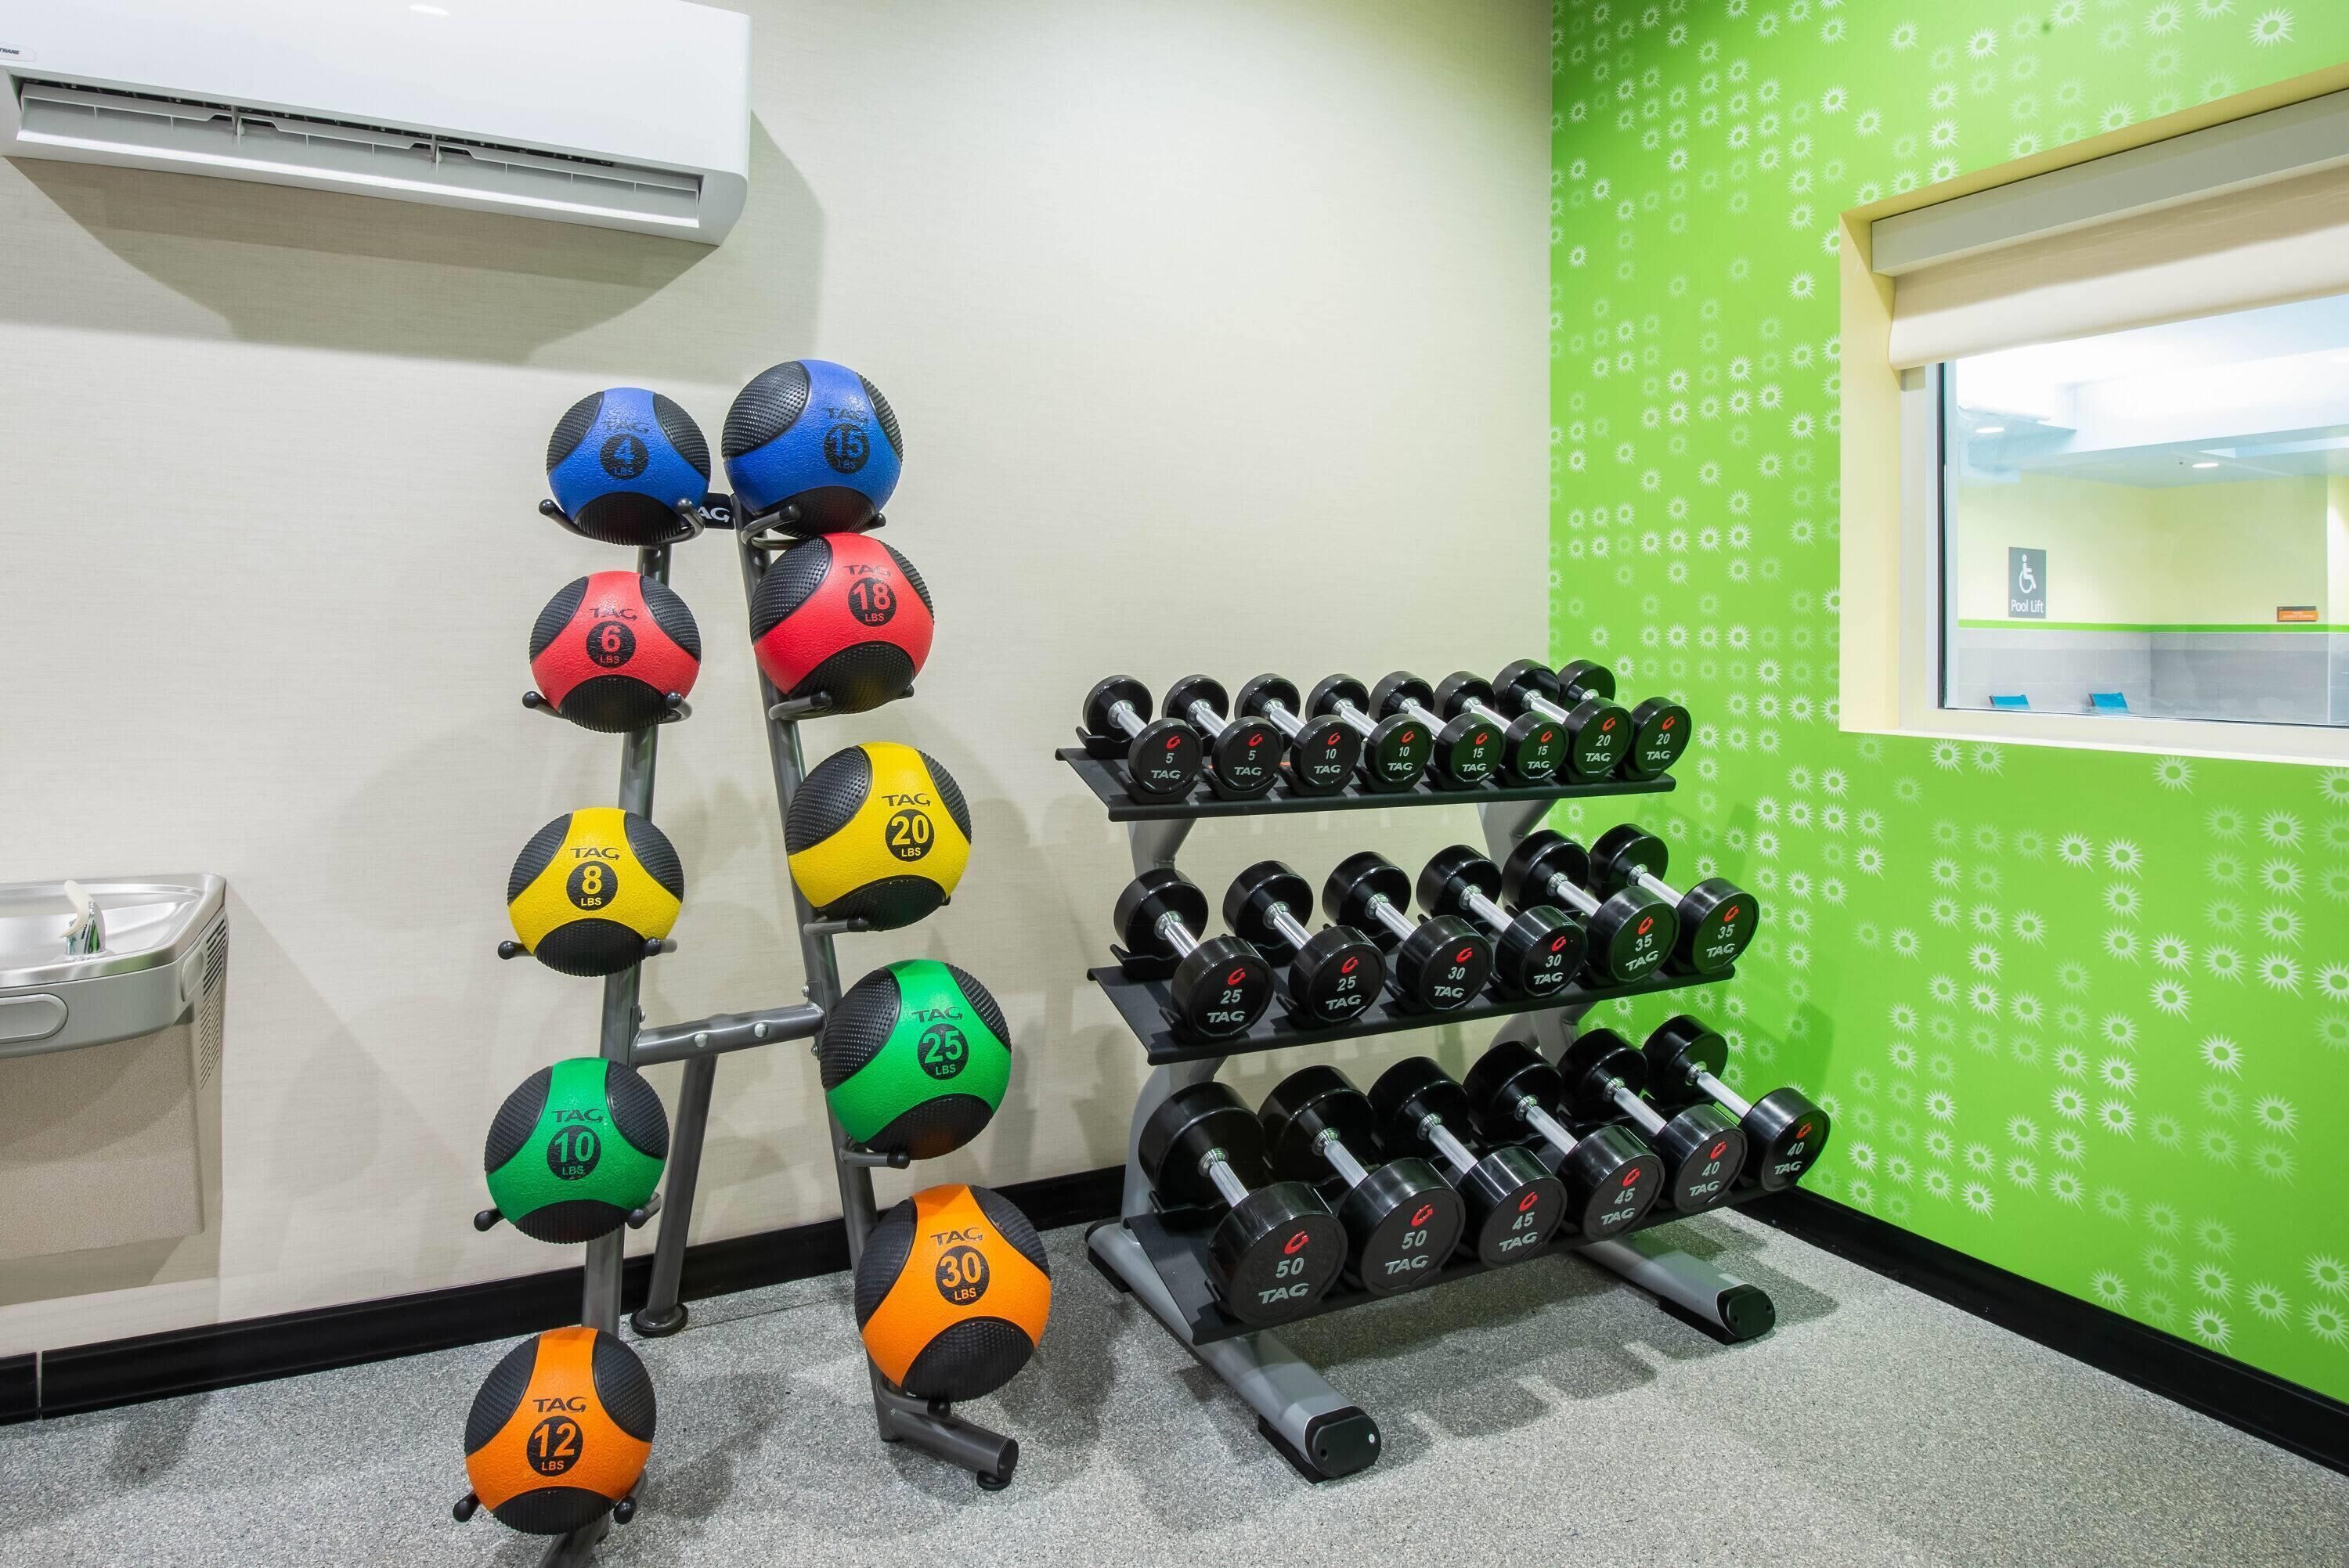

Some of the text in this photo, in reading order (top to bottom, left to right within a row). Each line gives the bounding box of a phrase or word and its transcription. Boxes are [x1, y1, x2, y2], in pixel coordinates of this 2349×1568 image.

[822, 408, 868, 423] TAG
[831, 428, 864, 458] 15
[614, 438, 635, 463] 4
[698, 506, 731, 523] AG
[843, 564, 891, 577] TAG
[853, 583, 891, 610] 18
[2011, 599, 2044, 613] Pool Lift
[589, 608, 637, 621] TAG
[865, 613, 885, 622] LBS
[601, 627, 620, 652] 6
[600, 655, 620, 664] LBS
[1596, 735, 1611, 747] 20
[1656, 734, 1670, 745] 20
[1248, 750, 1256, 761] 5
[1326, 748, 1337, 759] 10
[1399, 746, 1409, 757] 10
[1472, 748, 1484, 759] 15
[1537, 745, 1547, 756] 15
[1586, 752, 1611, 762] TAG
[1647, 750, 1671, 760] TAG
[1166, 753, 1174, 764] 5
[1527, 760, 1550, 770] TAG
[1234, 766, 1262, 777] TAG
[1314, 765, 1341, 774] TAG
[1387, 762, 1413, 771] TAG
[1462, 763, 1486, 772] TAG
[1151, 770, 1181, 780] TAG
[882, 793, 930, 807] TAG
[891, 815, 929, 845] 20
[570, 847, 620, 860] TAG
[901, 847, 921, 857] LBS
[582, 865, 602, 894] 8
[580, 897, 601, 907] LBS
[1718, 925, 1734, 939] 35
[1635, 935, 1653, 953] 35
[1706, 943, 1735, 958] TAG
[1545, 954, 1562, 968] 30
[1626, 950, 1658, 971] TAG
[1448, 967, 1465, 980] 30
[1533, 971, 1563, 985] TAG
[1337, 976, 1355, 992] 25
[1221, 989, 1241, 1004] 25
[1434, 986, 1464, 998] TAG
[1326, 994, 1362, 1010] TAG
[911, 1006, 963, 1023] TAG
[1207, 1010, 1246, 1023] TAG
[923, 1031, 962, 1064] 25
[935, 1065, 955, 1076] LBS
[551, 1109, 603, 1124] TAG
[554, 1132, 594, 1162] 10
[1787, 1142, 1805, 1156] 40
[562, 1166, 583, 1176] LBS
[1701, 1162, 1720, 1177] 40
[1774, 1161, 1803, 1174] TAG
[1615, 1187, 1634, 1205] 45
[1689, 1181, 1719, 1197] TAG
[1512, 1212, 1535, 1231] 45
[1600, 1207, 1636, 1225] TAG
[930, 1227, 983, 1246] TAG
[1401, 1230, 1427, 1250] 50
[1499, 1232, 1538, 1253] TAG
[941, 1253, 982, 1288] 30
[1276, 1258, 1304, 1278] 50
[1384, 1255, 1430, 1274] TAG
[954, 1287, 976, 1302] LBS
[1258, 1283, 1310, 1304] TAG
[533, 1397, 586, 1414] TAG
[534, 1422, 577, 1457] 12
[541, 1460, 564, 1472] LBS
